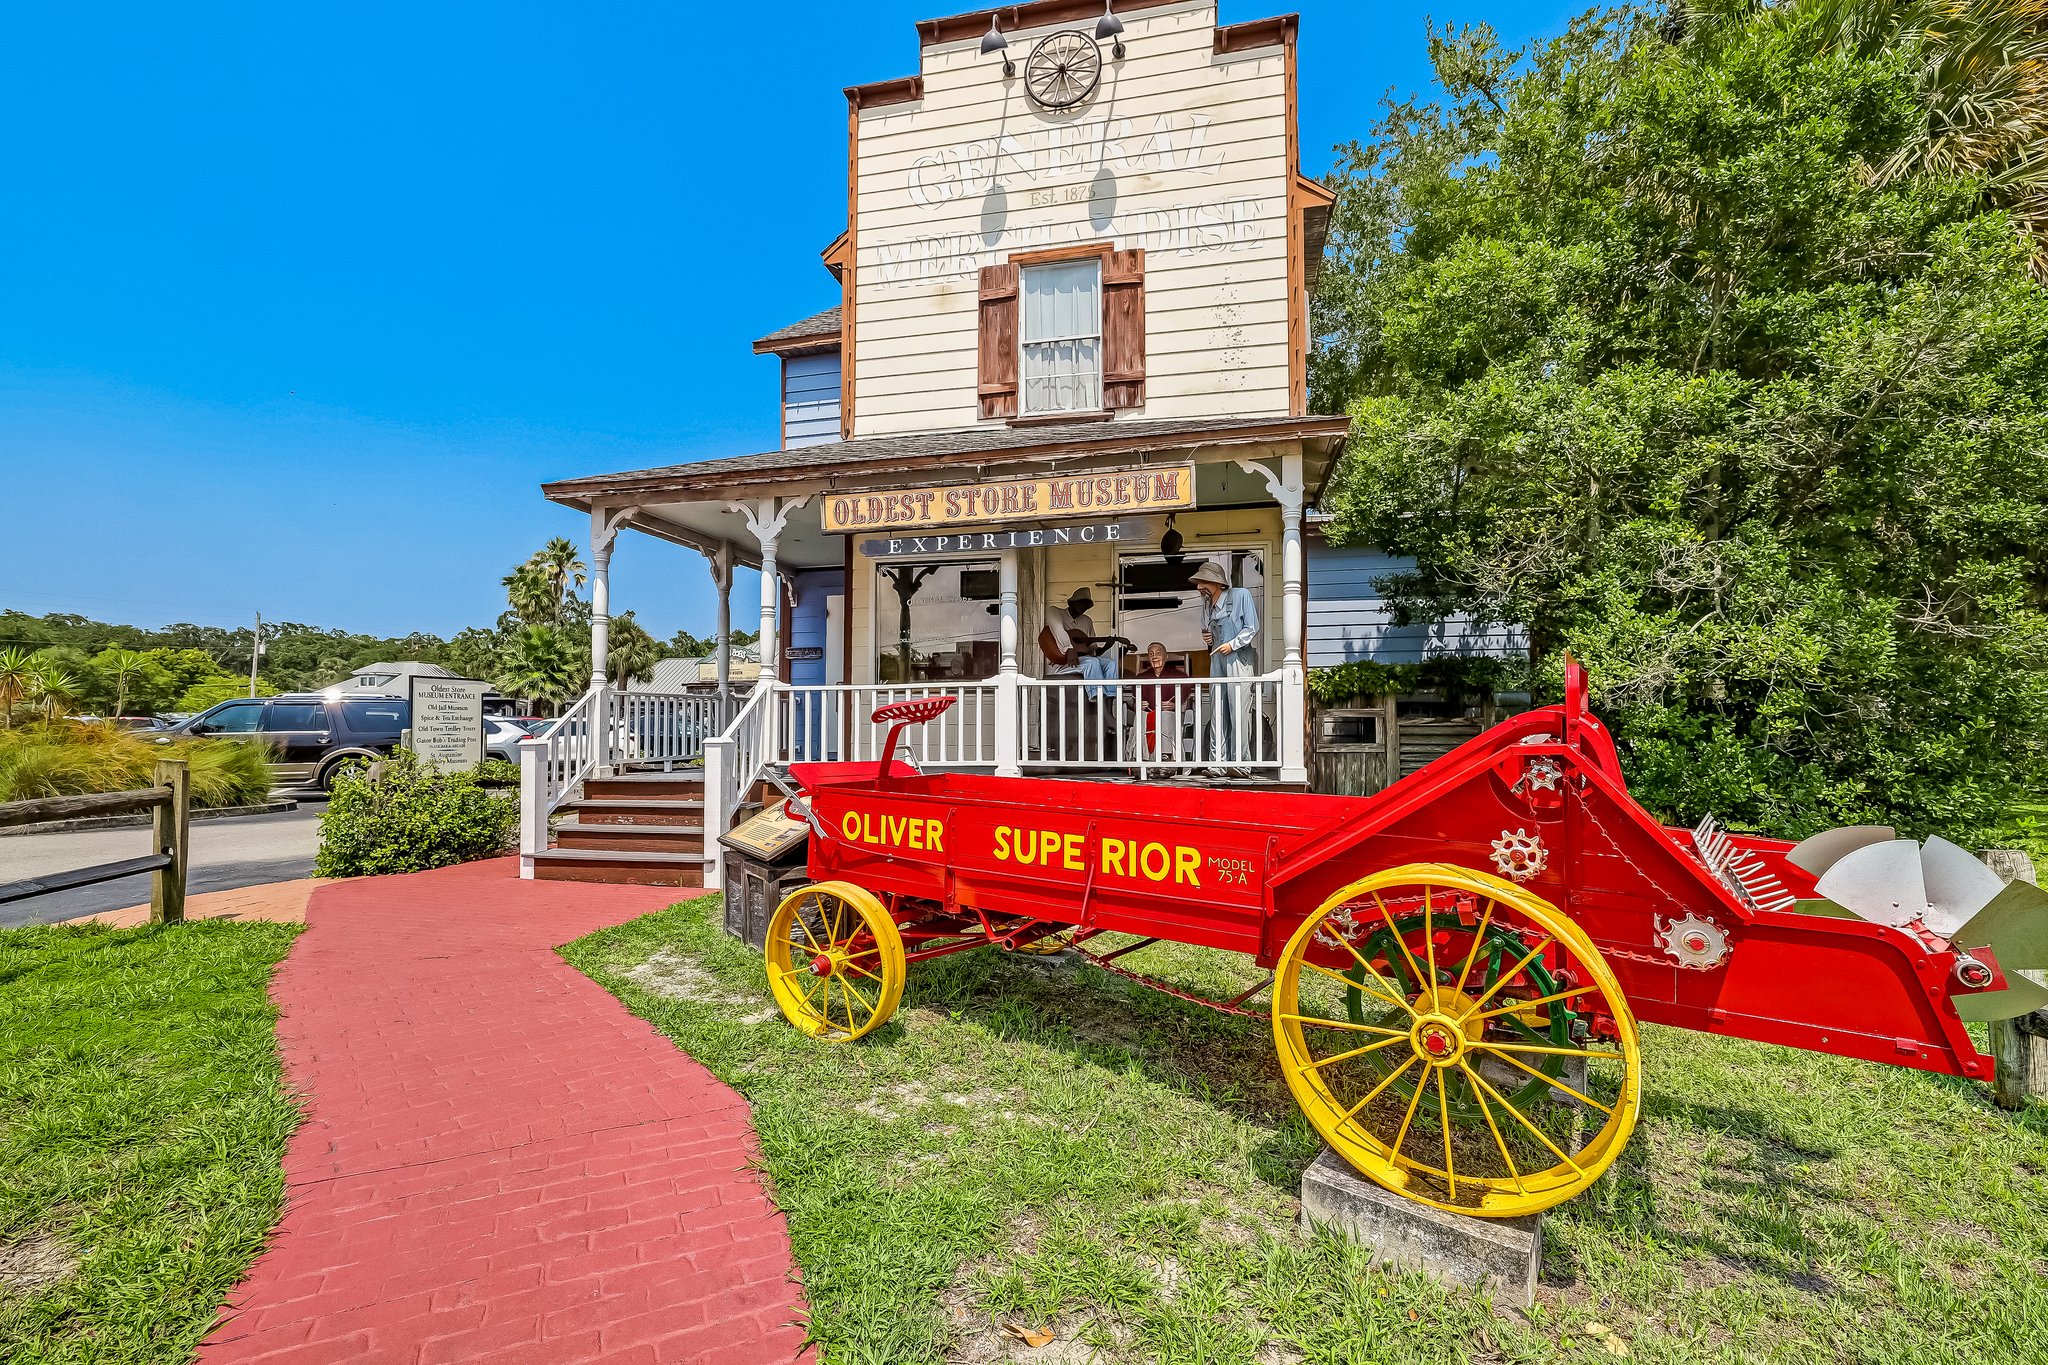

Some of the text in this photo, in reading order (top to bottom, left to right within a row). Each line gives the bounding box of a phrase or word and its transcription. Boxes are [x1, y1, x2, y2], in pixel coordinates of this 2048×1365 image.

[907, 112, 1227, 211] GENERAL
[1028, 187, 1058, 207] Est.
[833, 471, 1181, 526] OLDEST STORE MUSEUM
[888, 524, 1121, 554] EXPERIENCE
[418, 691, 477, 700] MUSEUM ENTRANCE
[451, 685, 466, 693] Store
[438, 704, 447, 712] Jail
[451, 714, 474, 722] Exchange
[842, 810, 944, 853] OLIVER
[1208, 856, 1256, 873] MODEL
